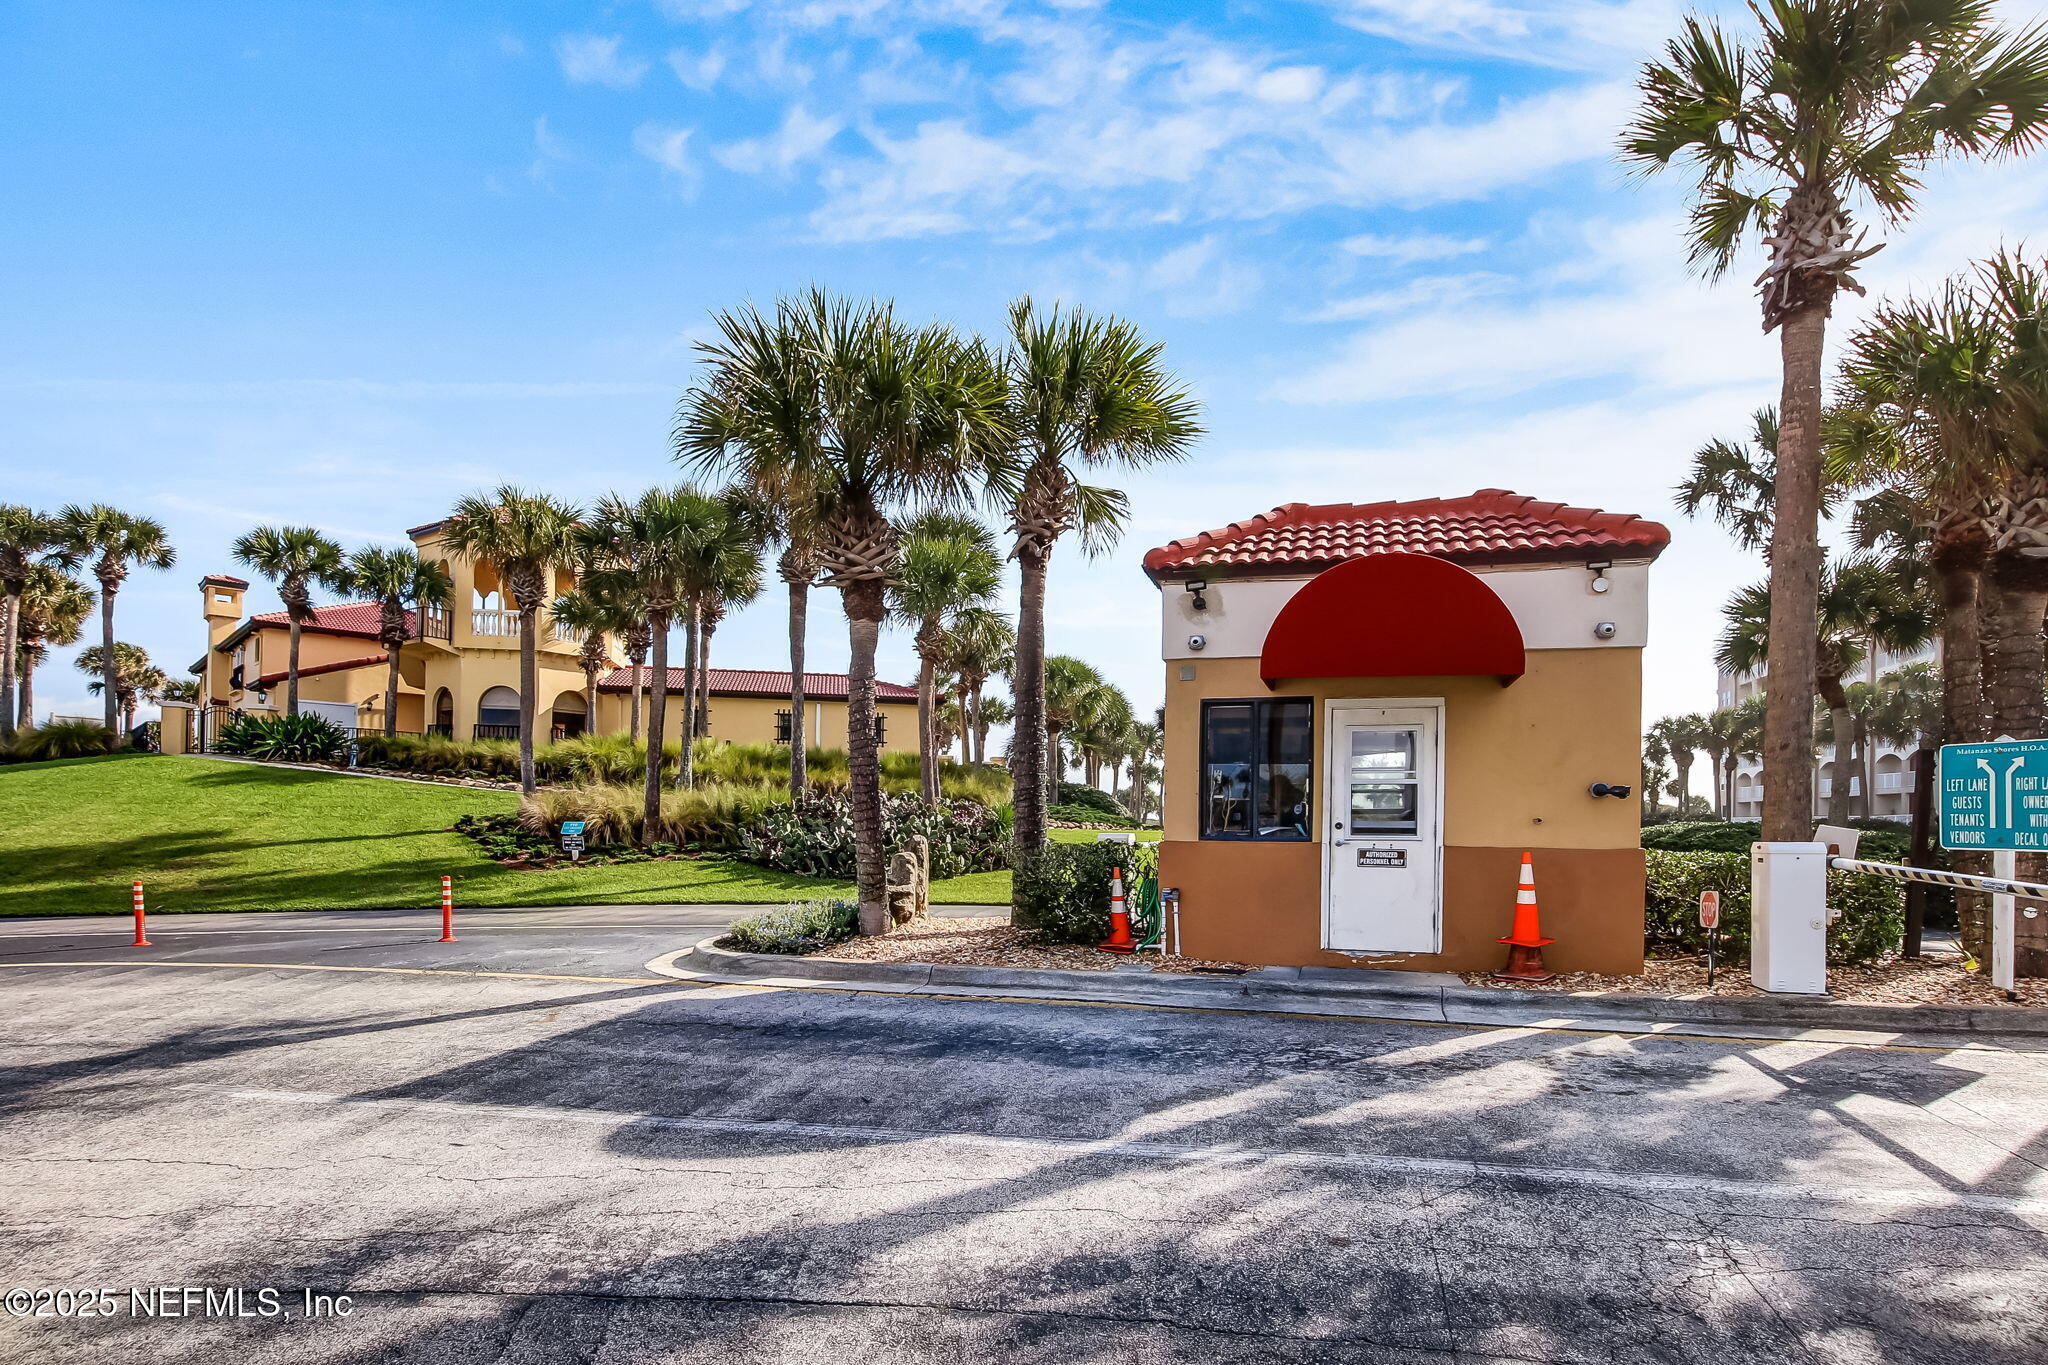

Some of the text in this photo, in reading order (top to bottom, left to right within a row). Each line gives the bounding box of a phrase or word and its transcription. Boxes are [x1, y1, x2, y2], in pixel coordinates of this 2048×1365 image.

[1946, 778, 1988, 791] LEFT LANE
[2015, 777, 2038, 790] RIGHT
[1952, 796, 1982, 809] GUESTS
[1950, 813, 1985, 827] TENANTS
[1950, 831, 1986, 844] VENDORS
[2014, 832, 2040, 846] DECAL
[1702, 901, 1716, 917] STOP
